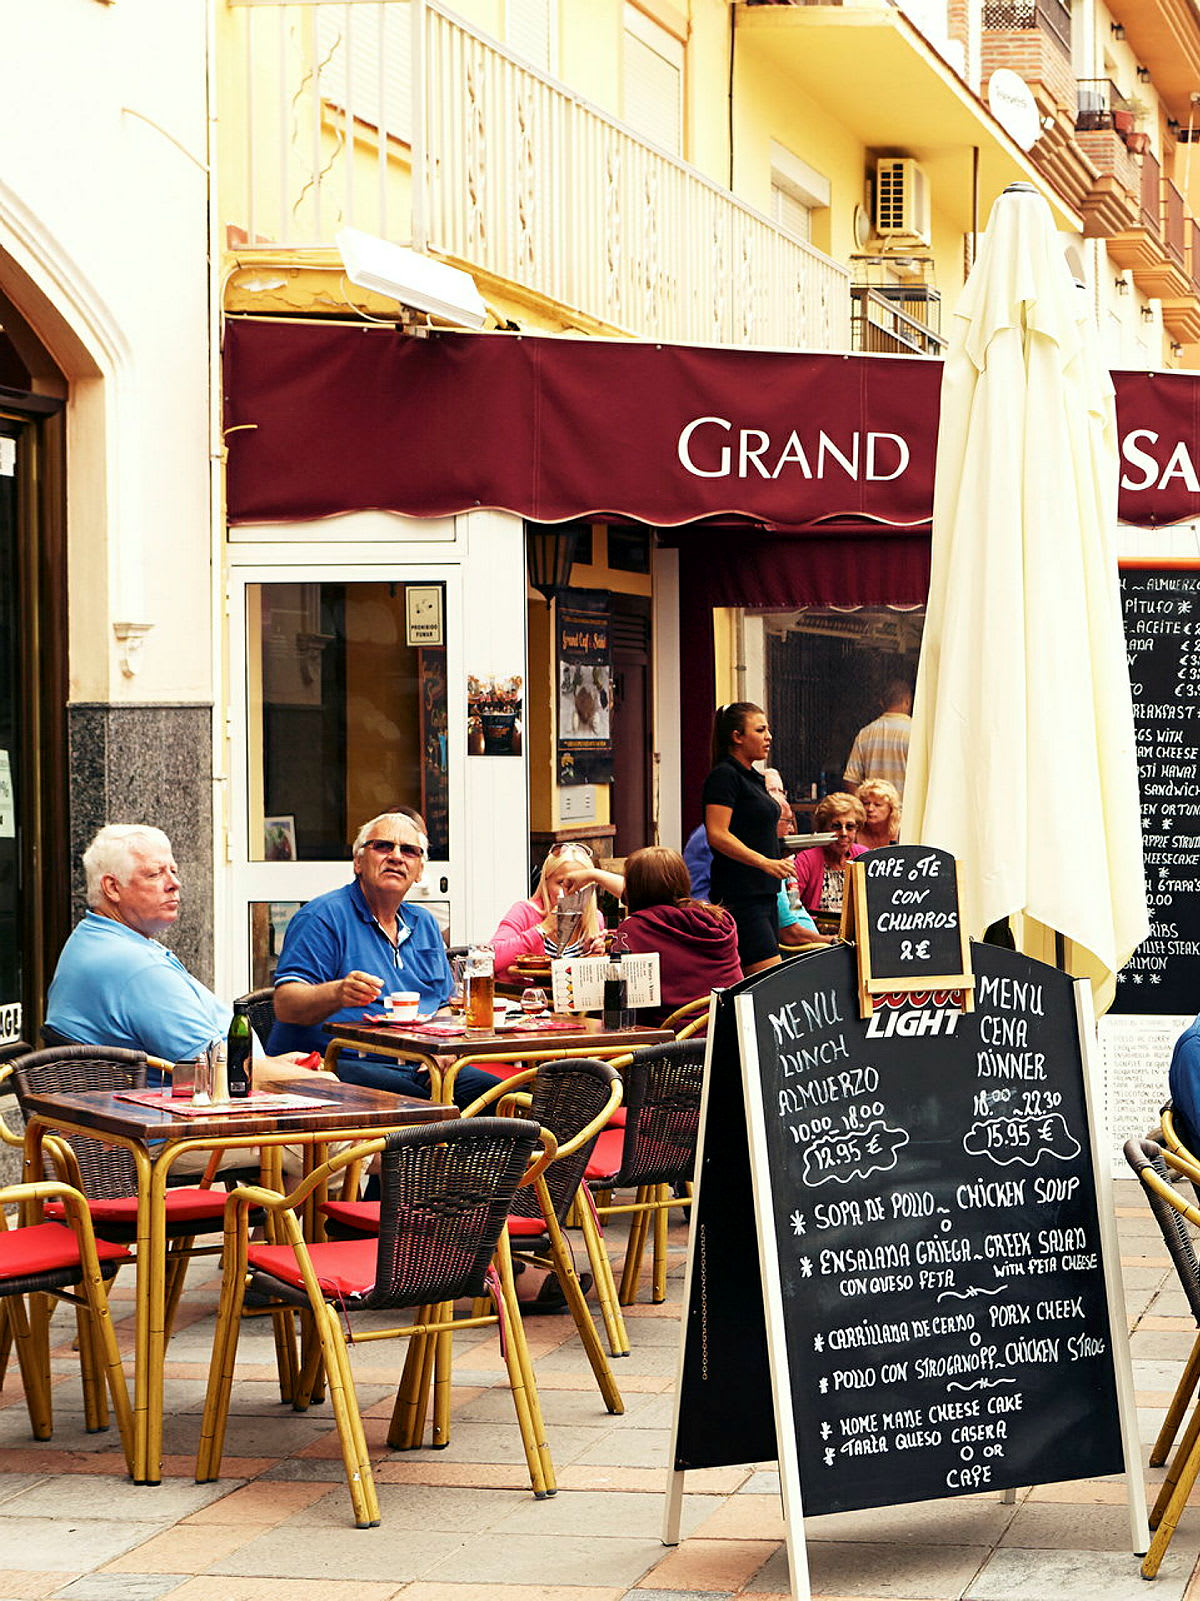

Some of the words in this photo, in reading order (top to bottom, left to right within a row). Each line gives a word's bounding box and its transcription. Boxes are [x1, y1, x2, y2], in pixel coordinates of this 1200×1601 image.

[678, 416, 910, 482] GRAND
[1125, 597, 1174, 614] PITUFO
[1136, 620, 1181, 634] ACEITE
[1133, 704, 1196, 719] REAKFAST
[1156, 746, 1199, 760] CHEESE
[1143, 852, 1200, 865] HEESECAKE
[891, 889, 930, 905] CON
[877, 911, 958, 932] CHURROS
[1167, 940, 1200, 956] STEAK
[979, 975, 1045, 1016] MENU
[768, 989, 844, 1045] MENU
[865, 1008, 965, 1039] LIGHT
[980, 1015, 1028, 1047] CENA
[780, 1034, 849, 1077] LUNCH
[977, 1049, 1047, 1080] DINNER
[779, 1066, 879, 1117] ALMUERZO
[987, 1123, 1031, 1148] 15.95
[814, 1203, 864, 1231] SOPA
[866, 1197, 885, 1222] DE
[891, 1191, 934, 1220] POLLO
[956, 1178, 1025, 1210] CHICKEN
[1033, 1177, 1080, 1205] SOUP
[915, 1233, 972, 1265] GRIEGA
[983, 1231, 1032, 1258] GREEK
[1038, 1227, 1087, 1253] SALAD
[993, 1258, 1024, 1279] WITH
[1061, 1253, 1098, 1272] CHEESE
[988, 1303, 1031, 1329] PORK
[1036, 1297, 1086, 1324] CHEEK
[832, 1366, 876, 1392] POLLO
[881, 1358, 909, 1383] CON
[1004, 1335, 1059, 1367] CHICKEN
[840, 1412, 878, 1436] HOME
[928, 1398, 981, 1425] CHEESE
[987, 1393, 1024, 1416] CAKE
[894, 1429, 942, 1449] QUESO
[951, 1421, 1008, 1445] CASERA
